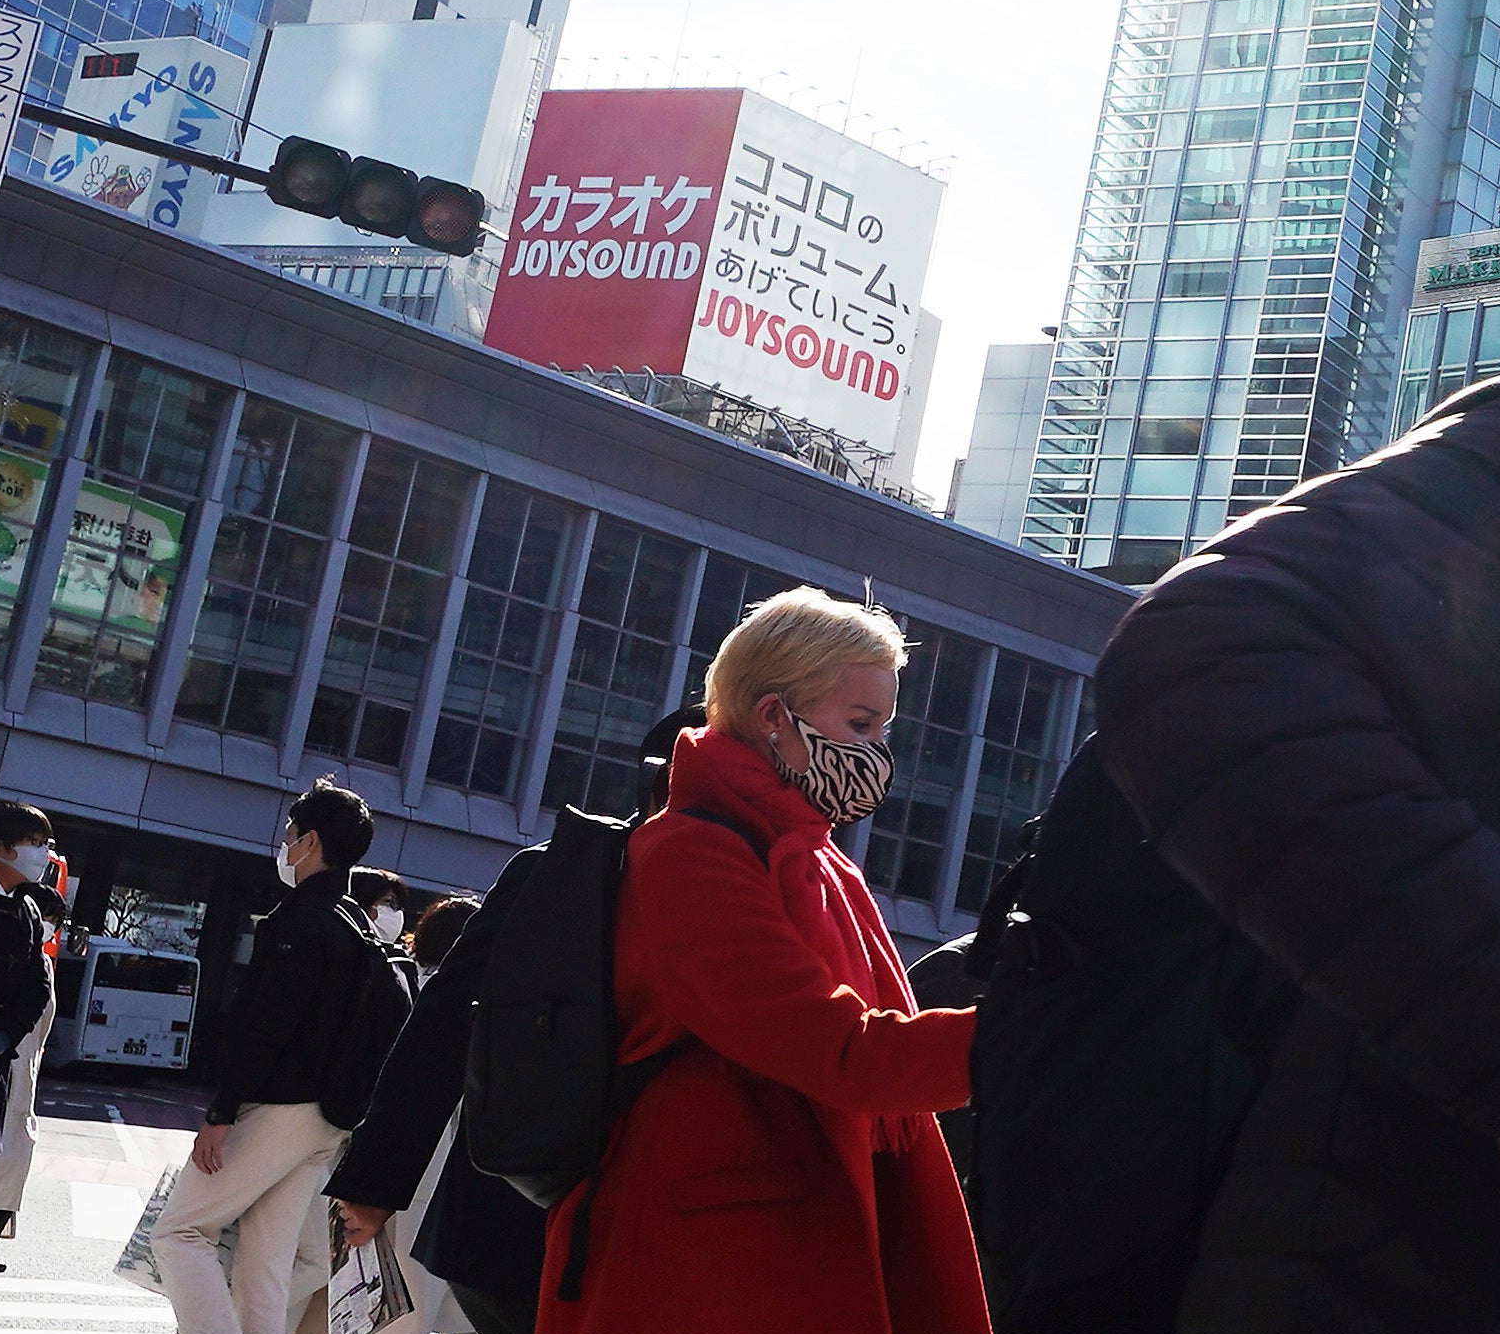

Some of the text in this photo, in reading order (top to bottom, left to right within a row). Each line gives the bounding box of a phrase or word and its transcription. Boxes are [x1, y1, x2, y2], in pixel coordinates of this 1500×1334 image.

[521, 174, 713, 236] カラオケ
[735, 143, 884, 244] ココロの
[508, 238, 703, 282] JOYSOUND
[715, 247, 907, 357] あげていこう。
[724, 198, 911, 316] ボリューム、
[698, 288, 900, 402] JOYSOUND
